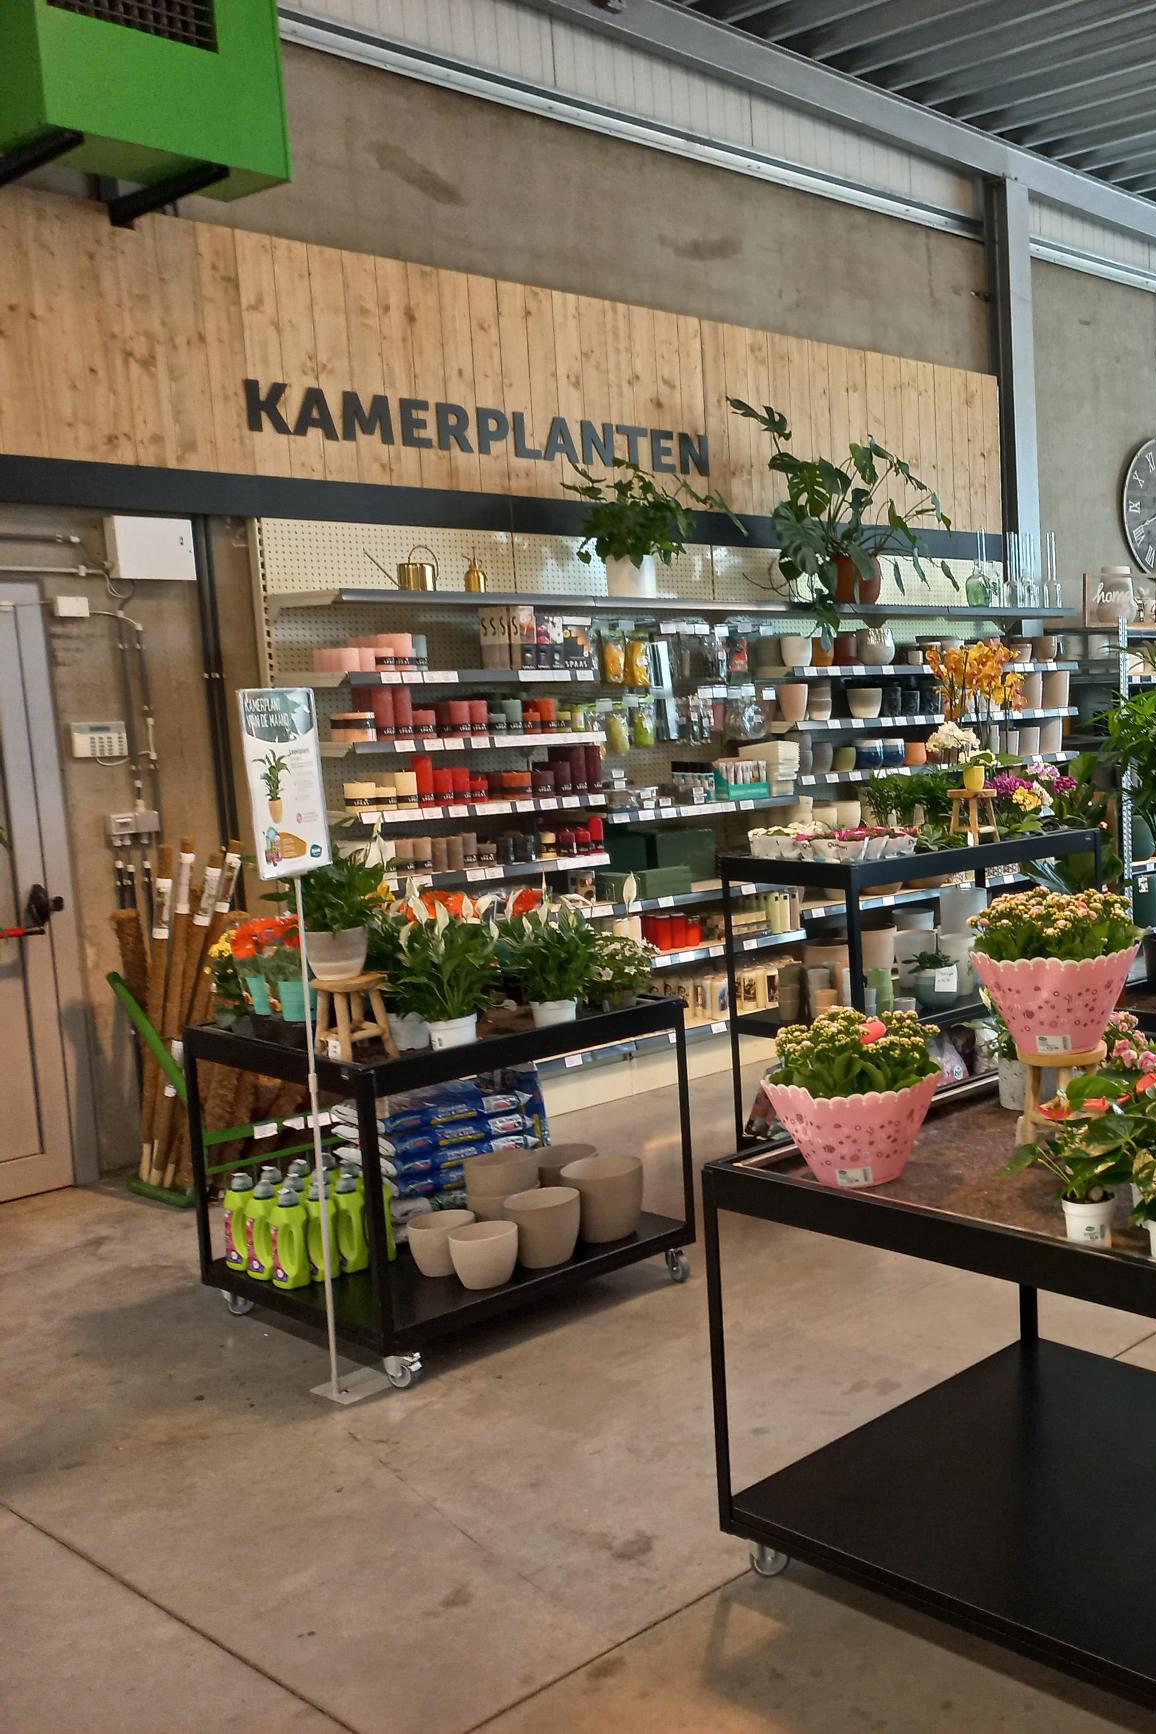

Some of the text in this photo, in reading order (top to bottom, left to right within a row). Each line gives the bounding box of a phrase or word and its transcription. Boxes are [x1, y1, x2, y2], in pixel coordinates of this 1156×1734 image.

[244, 378, 710, 477] KAMERPLANTEN
[1132, 471, 1144, 488] X
[564, 659, 588, 669] SPAAS
[260, 713, 269, 728] DE
